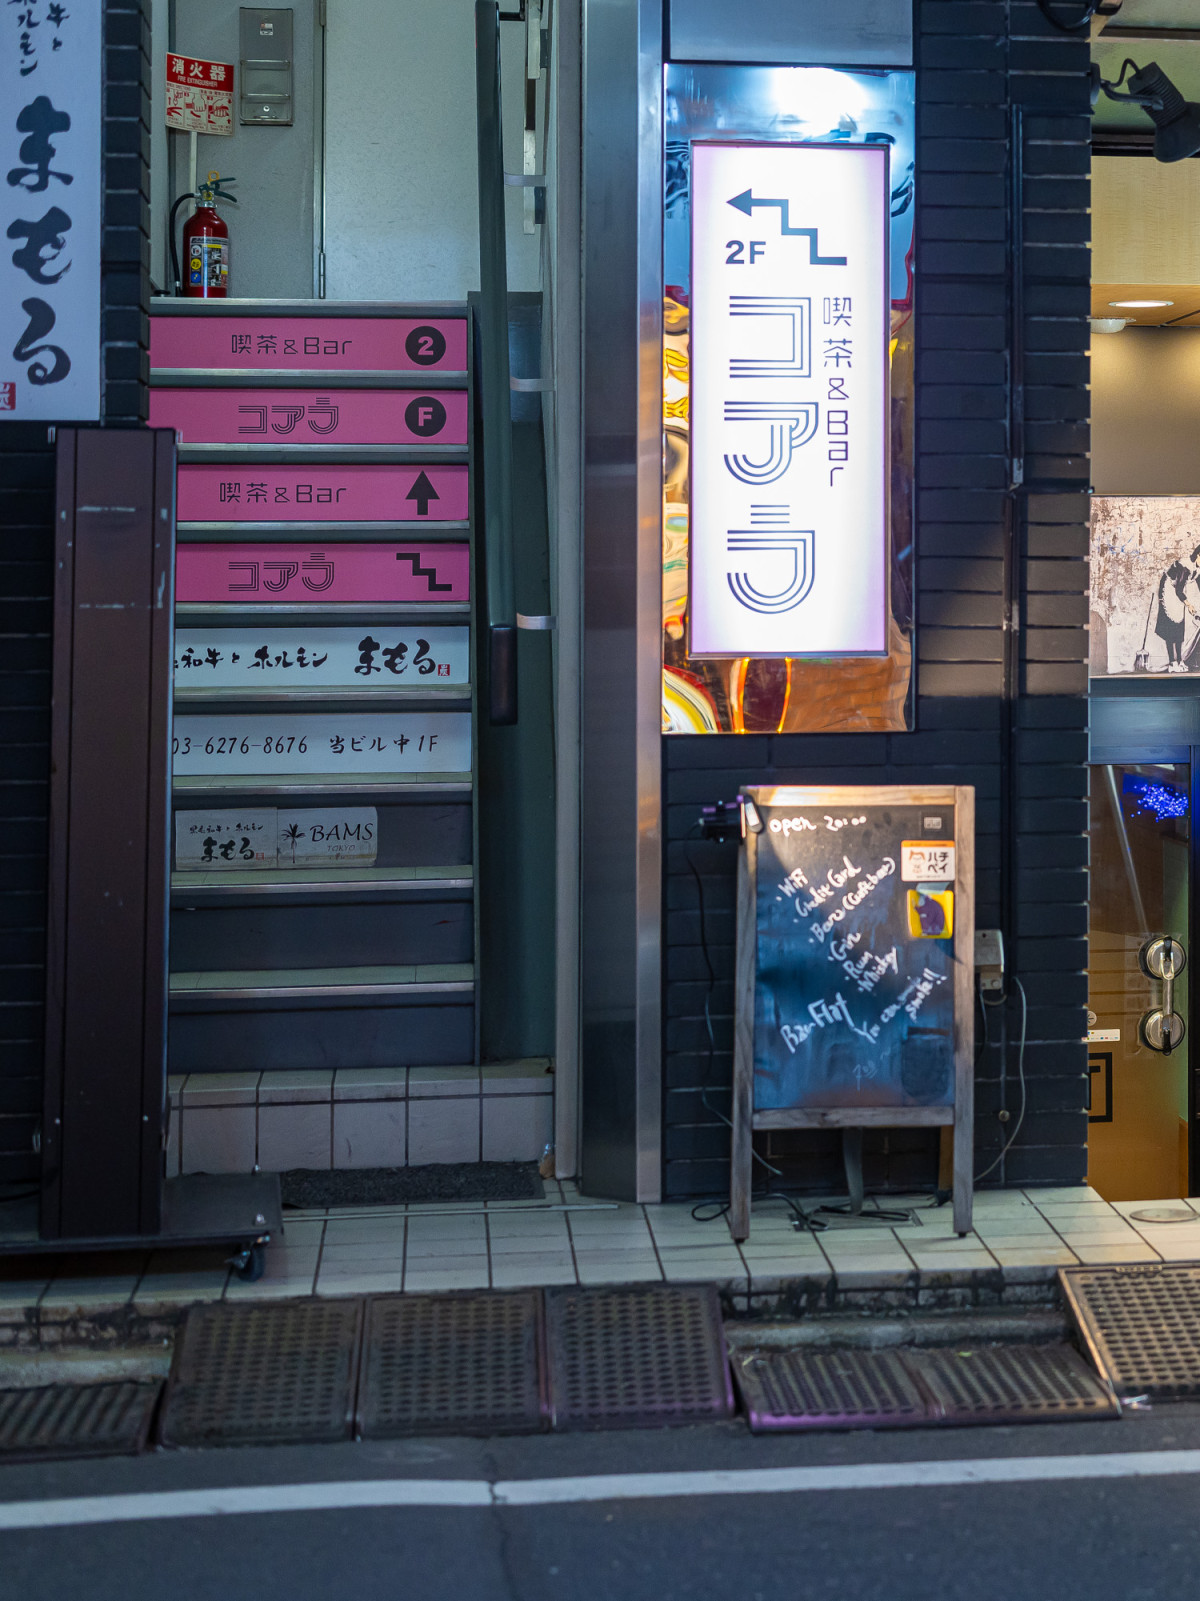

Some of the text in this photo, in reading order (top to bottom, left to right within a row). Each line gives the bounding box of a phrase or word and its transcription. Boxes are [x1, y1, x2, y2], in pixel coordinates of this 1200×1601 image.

[7, 0, 41, 77] ルモン
[172, 57, 226, 81] 消火器
[187, 77, 218, 87] EXTINGUISHER
[7, 96, 74, 386] まもる
[725, 240, 766, 265] 2F
[231, 334, 434, 356] 喫茶&Bar 2
[822, 296, 852, 488] 喫茶&Bar
[238, 397, 433, 435] コアラ F
[723, 295, 819, 616] コアラ
[219, 482, 347, 504] 喫茶&Bar
[228, 553, 335, 592] コアラ
[174, 645, 328, 670] 和牛とホルモン
[354, 635, 437, 677] まもる
[173, 735, 308, 755] 03-6276-8676
[309, 822, 374, 842] BAMS
[201, 836, 255, 863] まもる
[928, 852, 949, 862] ハチ
[830, 932, 862, 961] Gin
